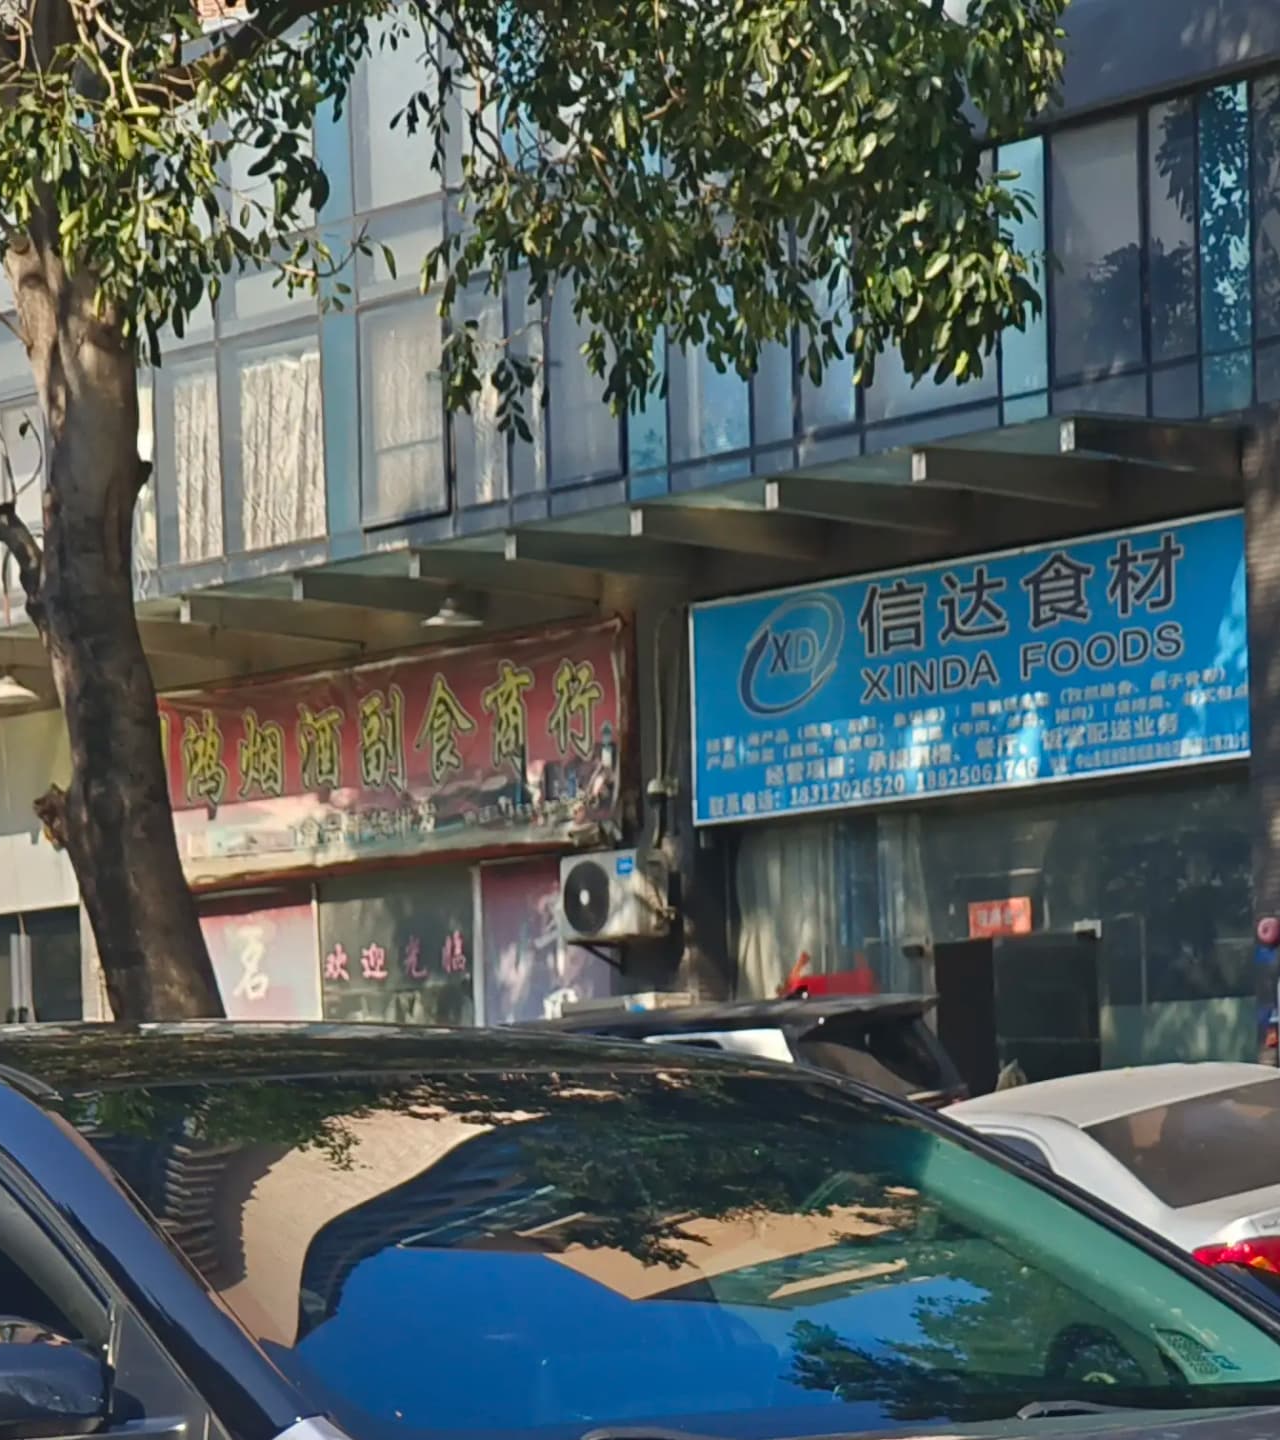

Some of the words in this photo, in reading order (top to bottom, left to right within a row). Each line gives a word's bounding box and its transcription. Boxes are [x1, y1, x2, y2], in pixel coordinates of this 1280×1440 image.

[858, 532, 1184, 657] 信达食材
[768, 624, 822, 675] XD
[860, 651, 1000, 705] XINDA
[1019, 622, 1185, 682] FOODS
[160, 656, 608, 810] 鸿烟酒副食商行
[324, 929, 468, 982] 欢迎光临
